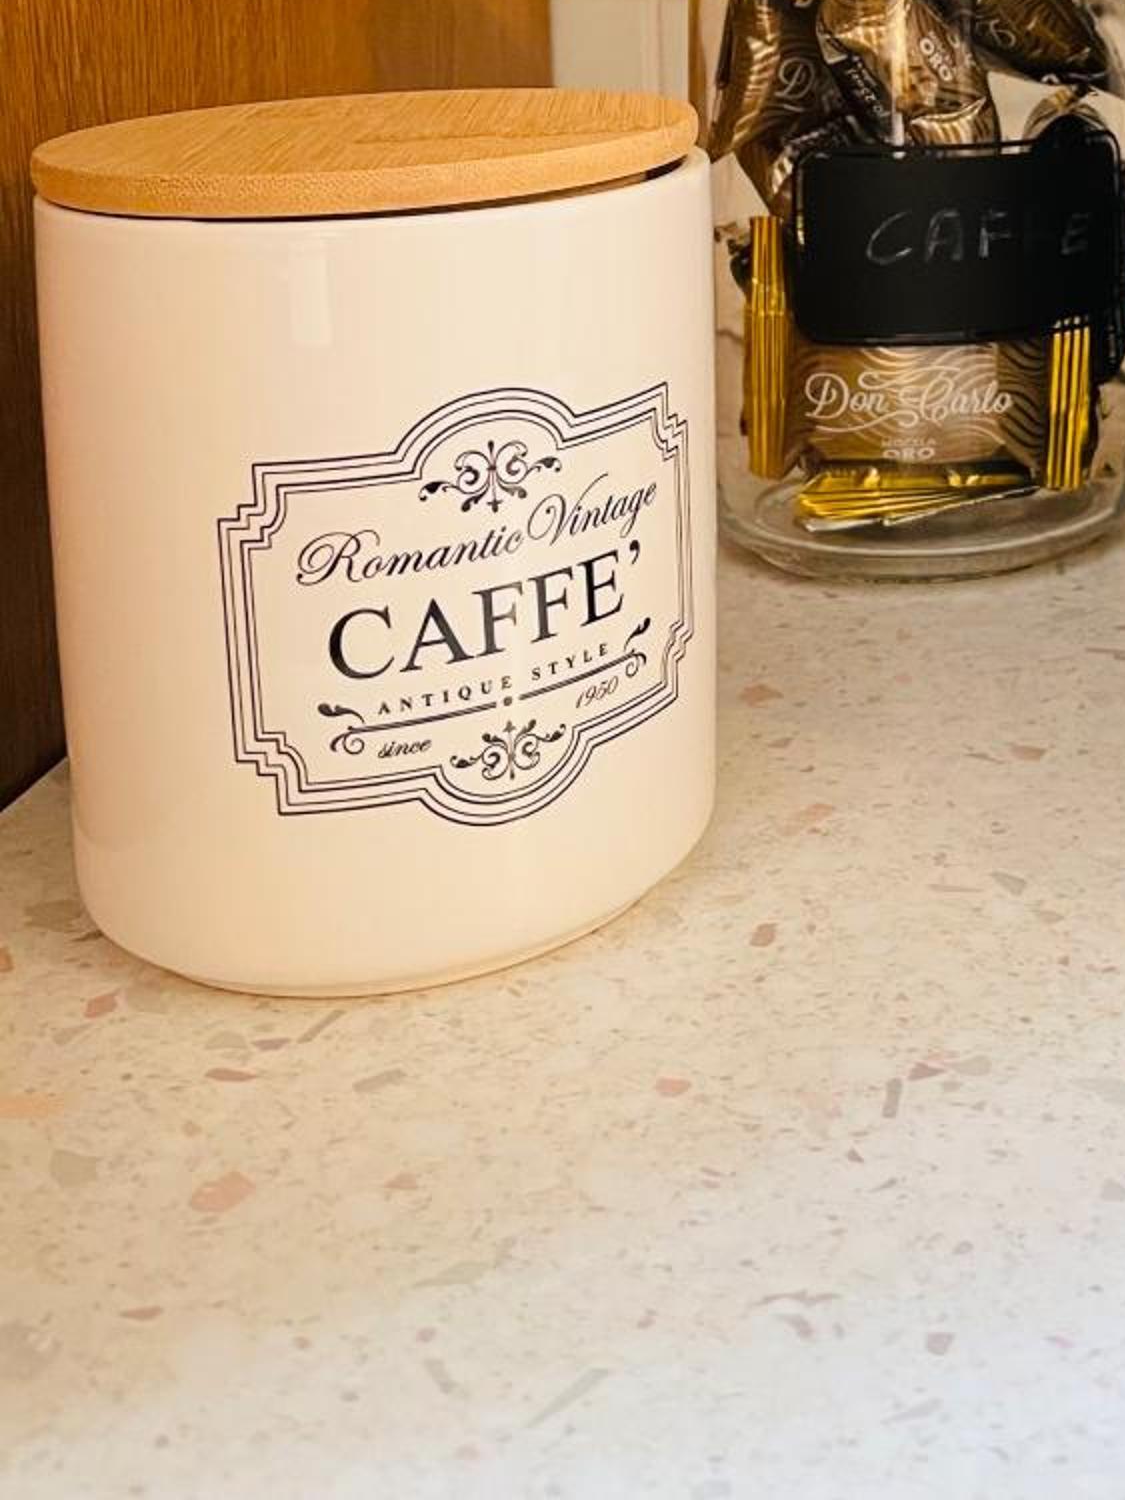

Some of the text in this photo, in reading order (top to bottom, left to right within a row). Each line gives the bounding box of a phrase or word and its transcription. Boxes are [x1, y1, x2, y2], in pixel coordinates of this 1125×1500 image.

[865, 208, 1093, 266] CAFE
[804, 368, 1013, 424] Don Carlo
[881, 447, 936, 462] ORO
[296, 473, 657, 586] Romantic Vintage
[377, 642, 609, 715] ANTIQUE STYLE
[377, 676, 620, 759] since 1950
